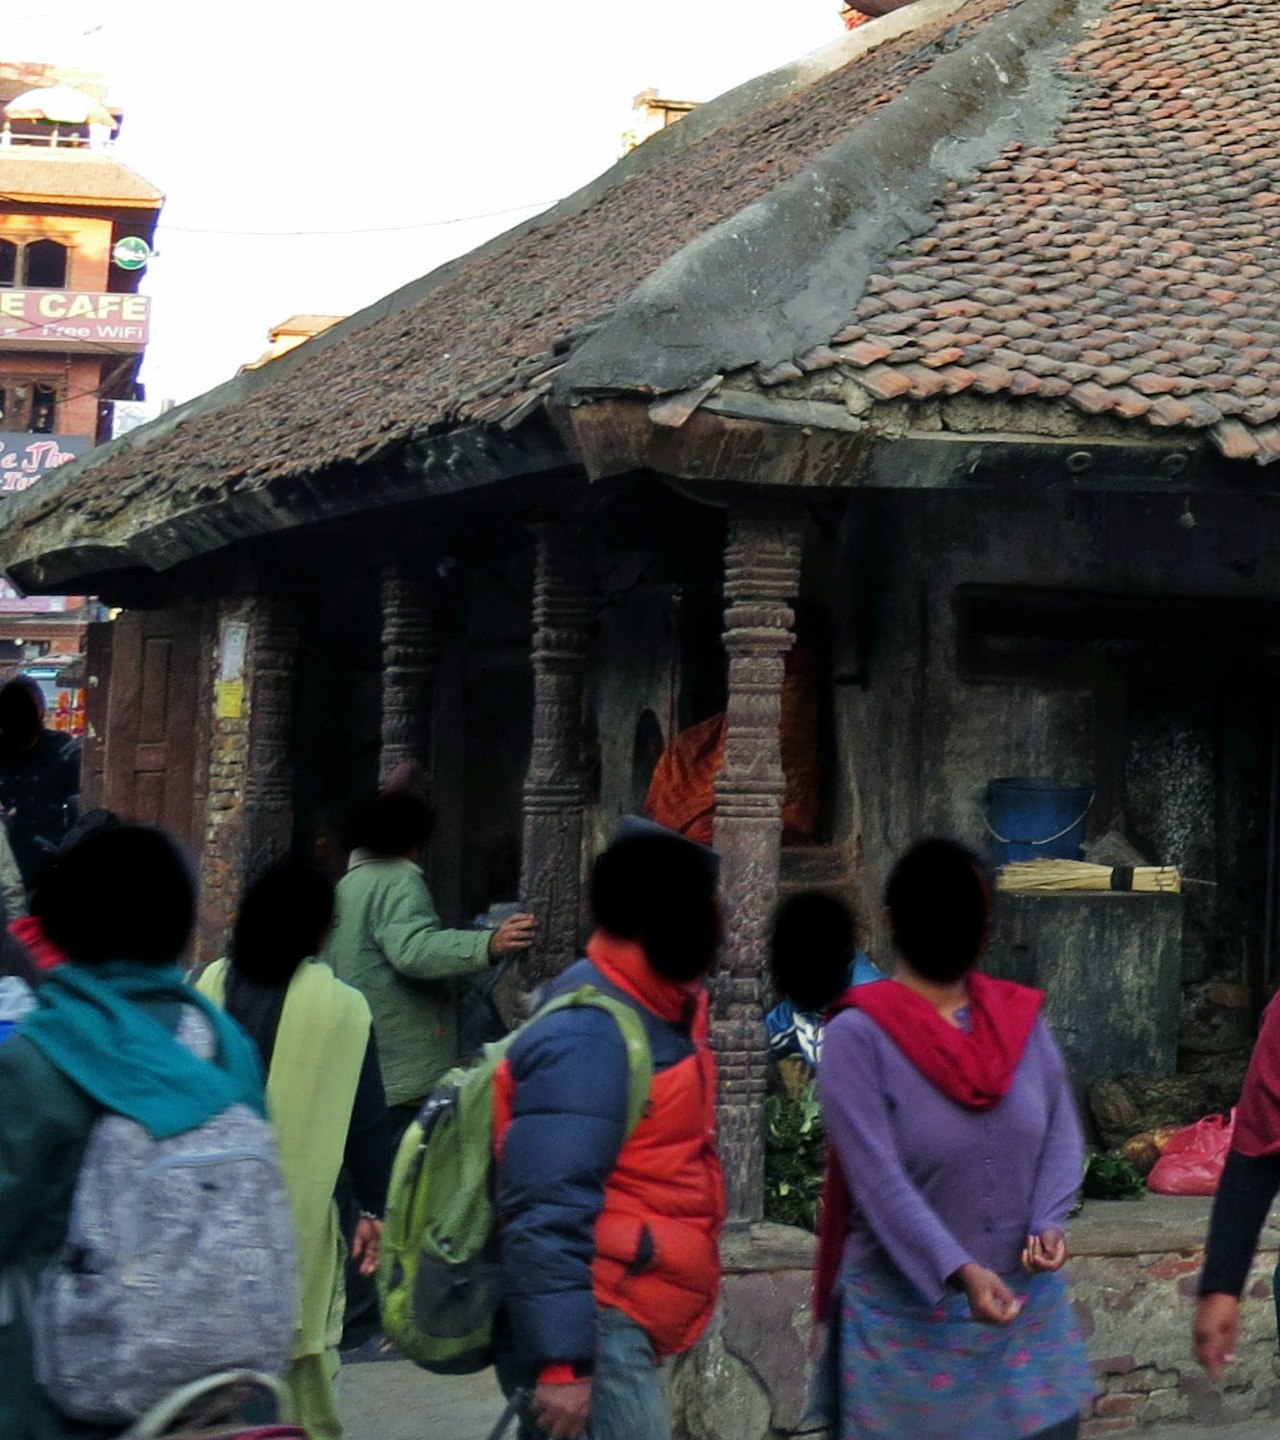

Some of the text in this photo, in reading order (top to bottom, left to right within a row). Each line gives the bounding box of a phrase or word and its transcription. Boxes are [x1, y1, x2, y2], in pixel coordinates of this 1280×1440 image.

[39, 293, 147, 322] CAFE
[42, 323, 143, 340] Free WiFi
